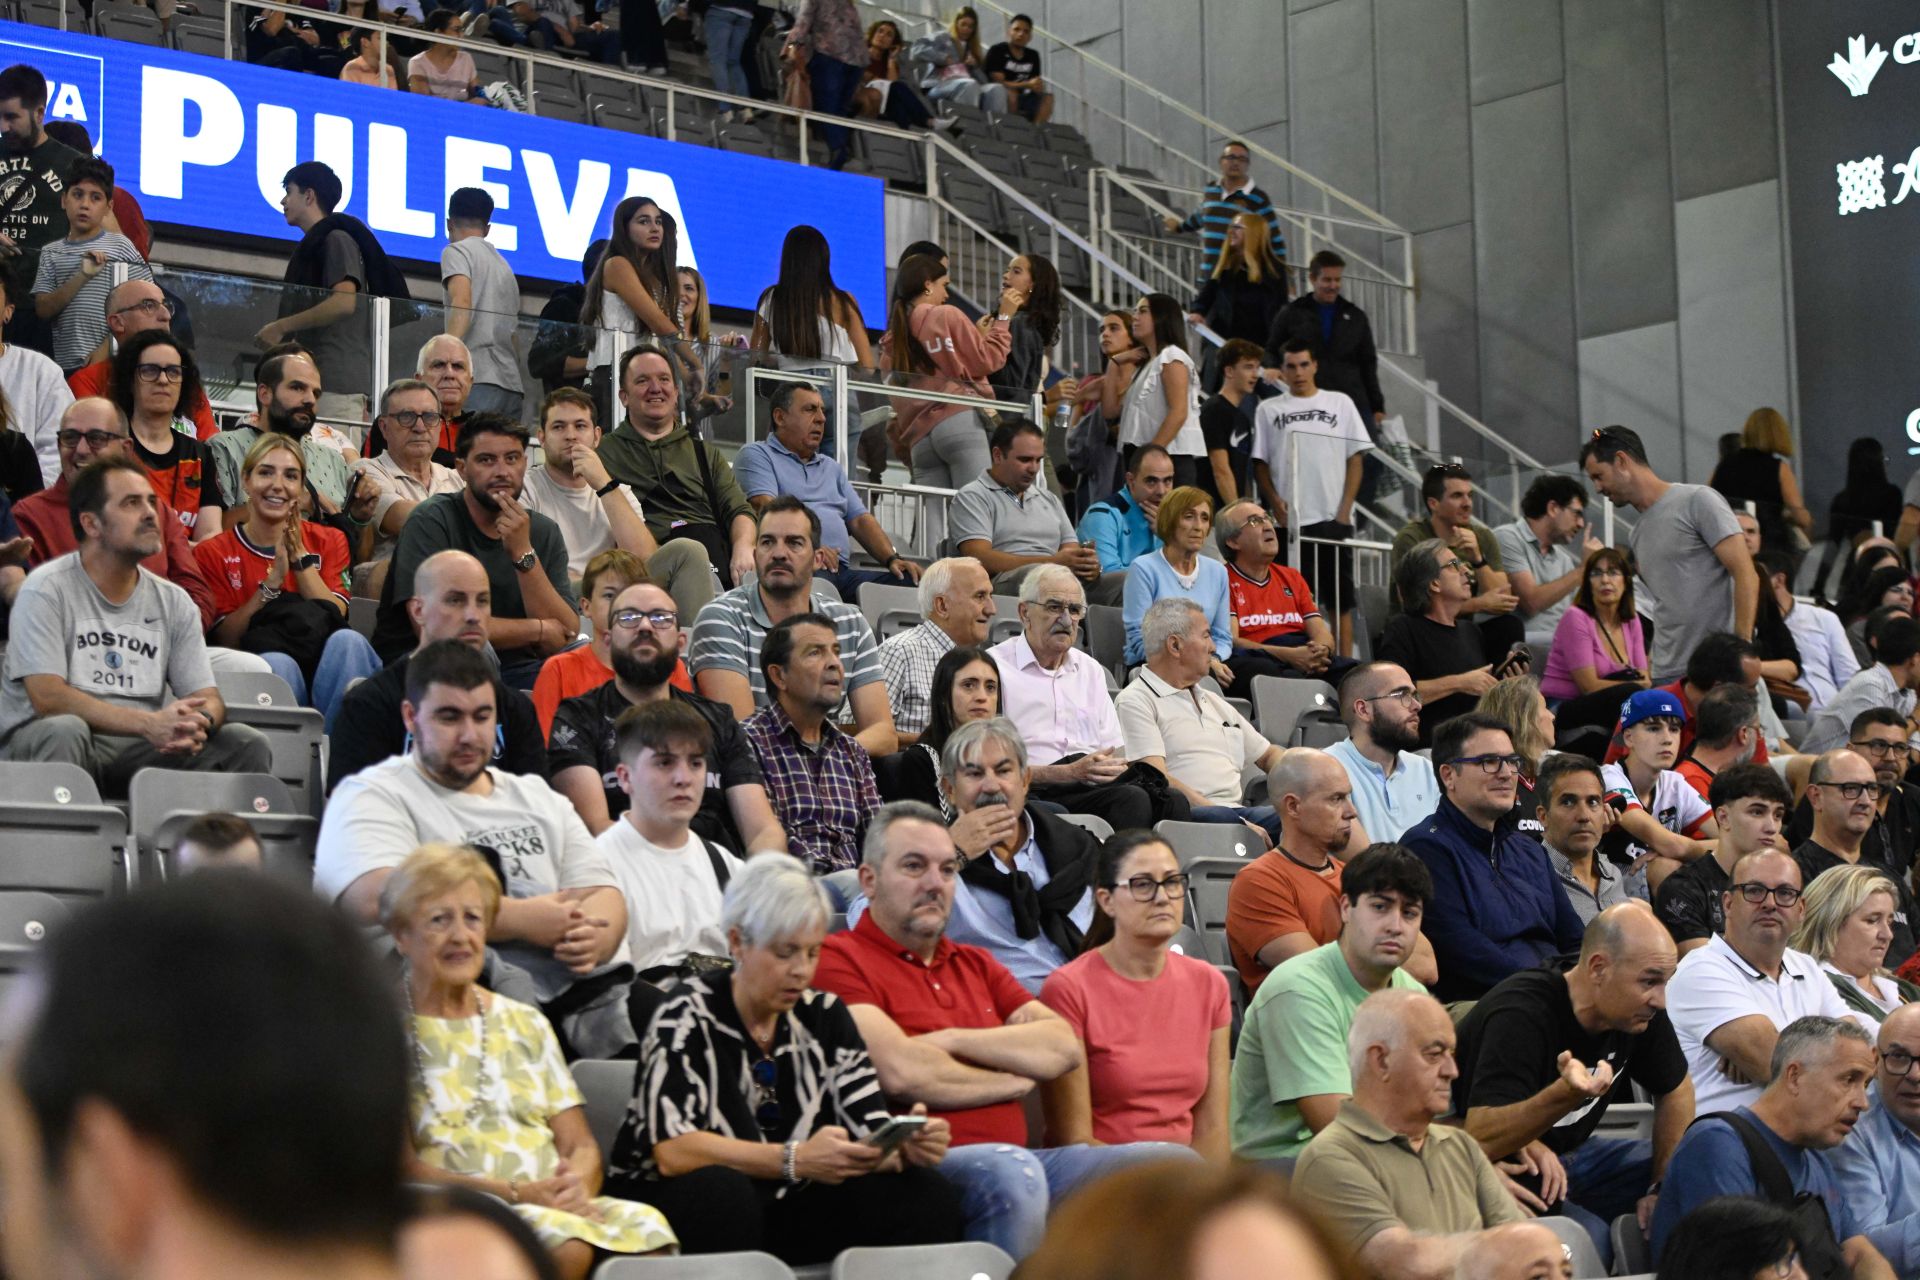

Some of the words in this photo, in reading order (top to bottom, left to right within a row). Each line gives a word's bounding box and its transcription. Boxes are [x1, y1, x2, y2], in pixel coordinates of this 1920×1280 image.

[32, 216, 49, 225] DIV
[77, 631, 158, 660] BOSTON
[93, 670, 134, 689] 2011
